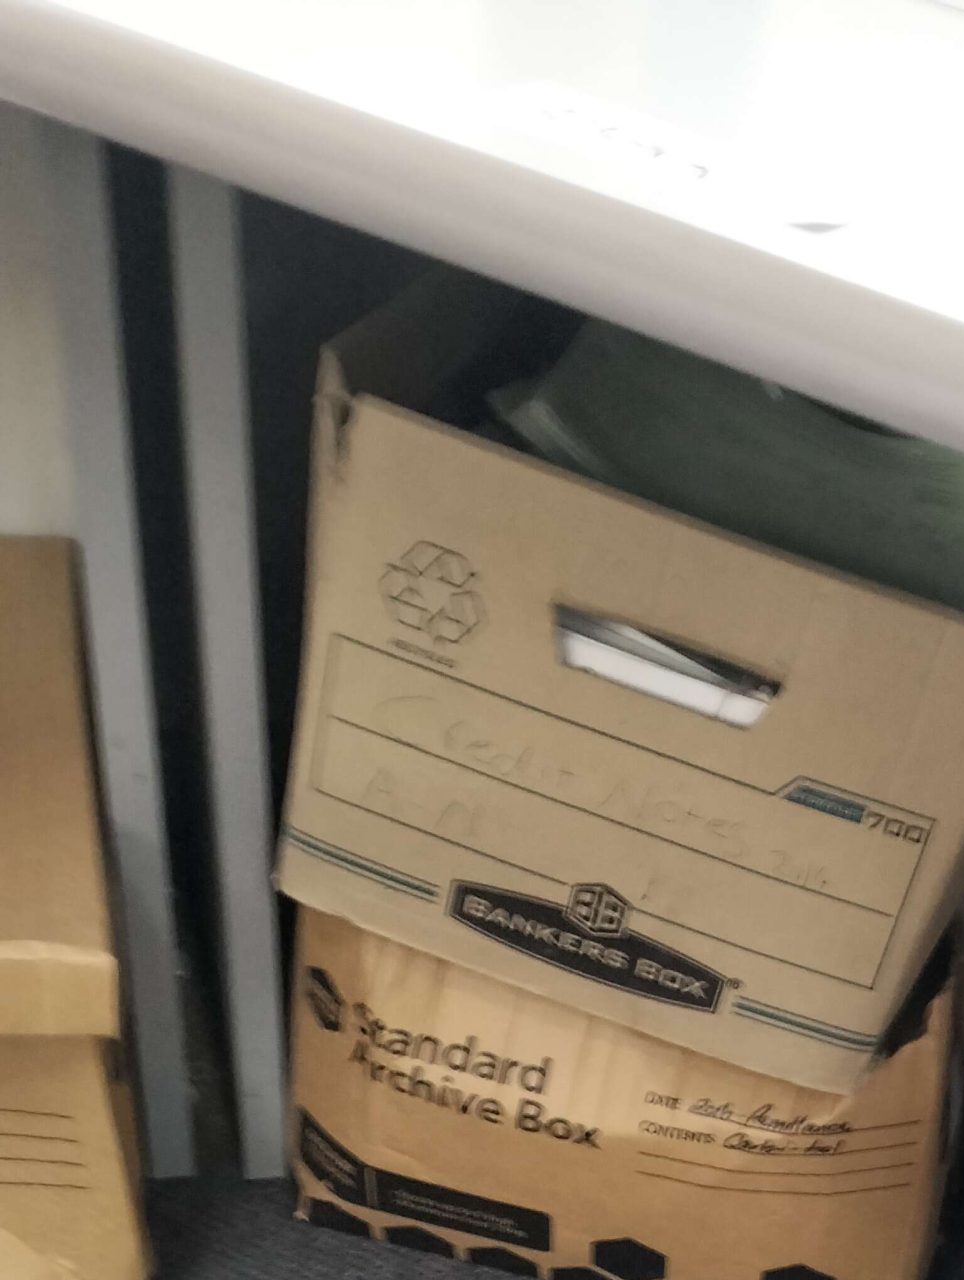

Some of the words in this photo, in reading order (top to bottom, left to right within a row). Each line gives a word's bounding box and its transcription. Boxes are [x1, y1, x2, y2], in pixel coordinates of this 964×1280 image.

[866, 810, 923, 844] 700
[462, 893, 631, 970] BANKERS
[634, 956, 710, 1001] BOX
[351, 1038, 505, 1125] Archive
[514, 1097, 603, 1150] Box
[352, 1001, 554, 1095] Standard
[644, 1091, 681, 1111] DATE
